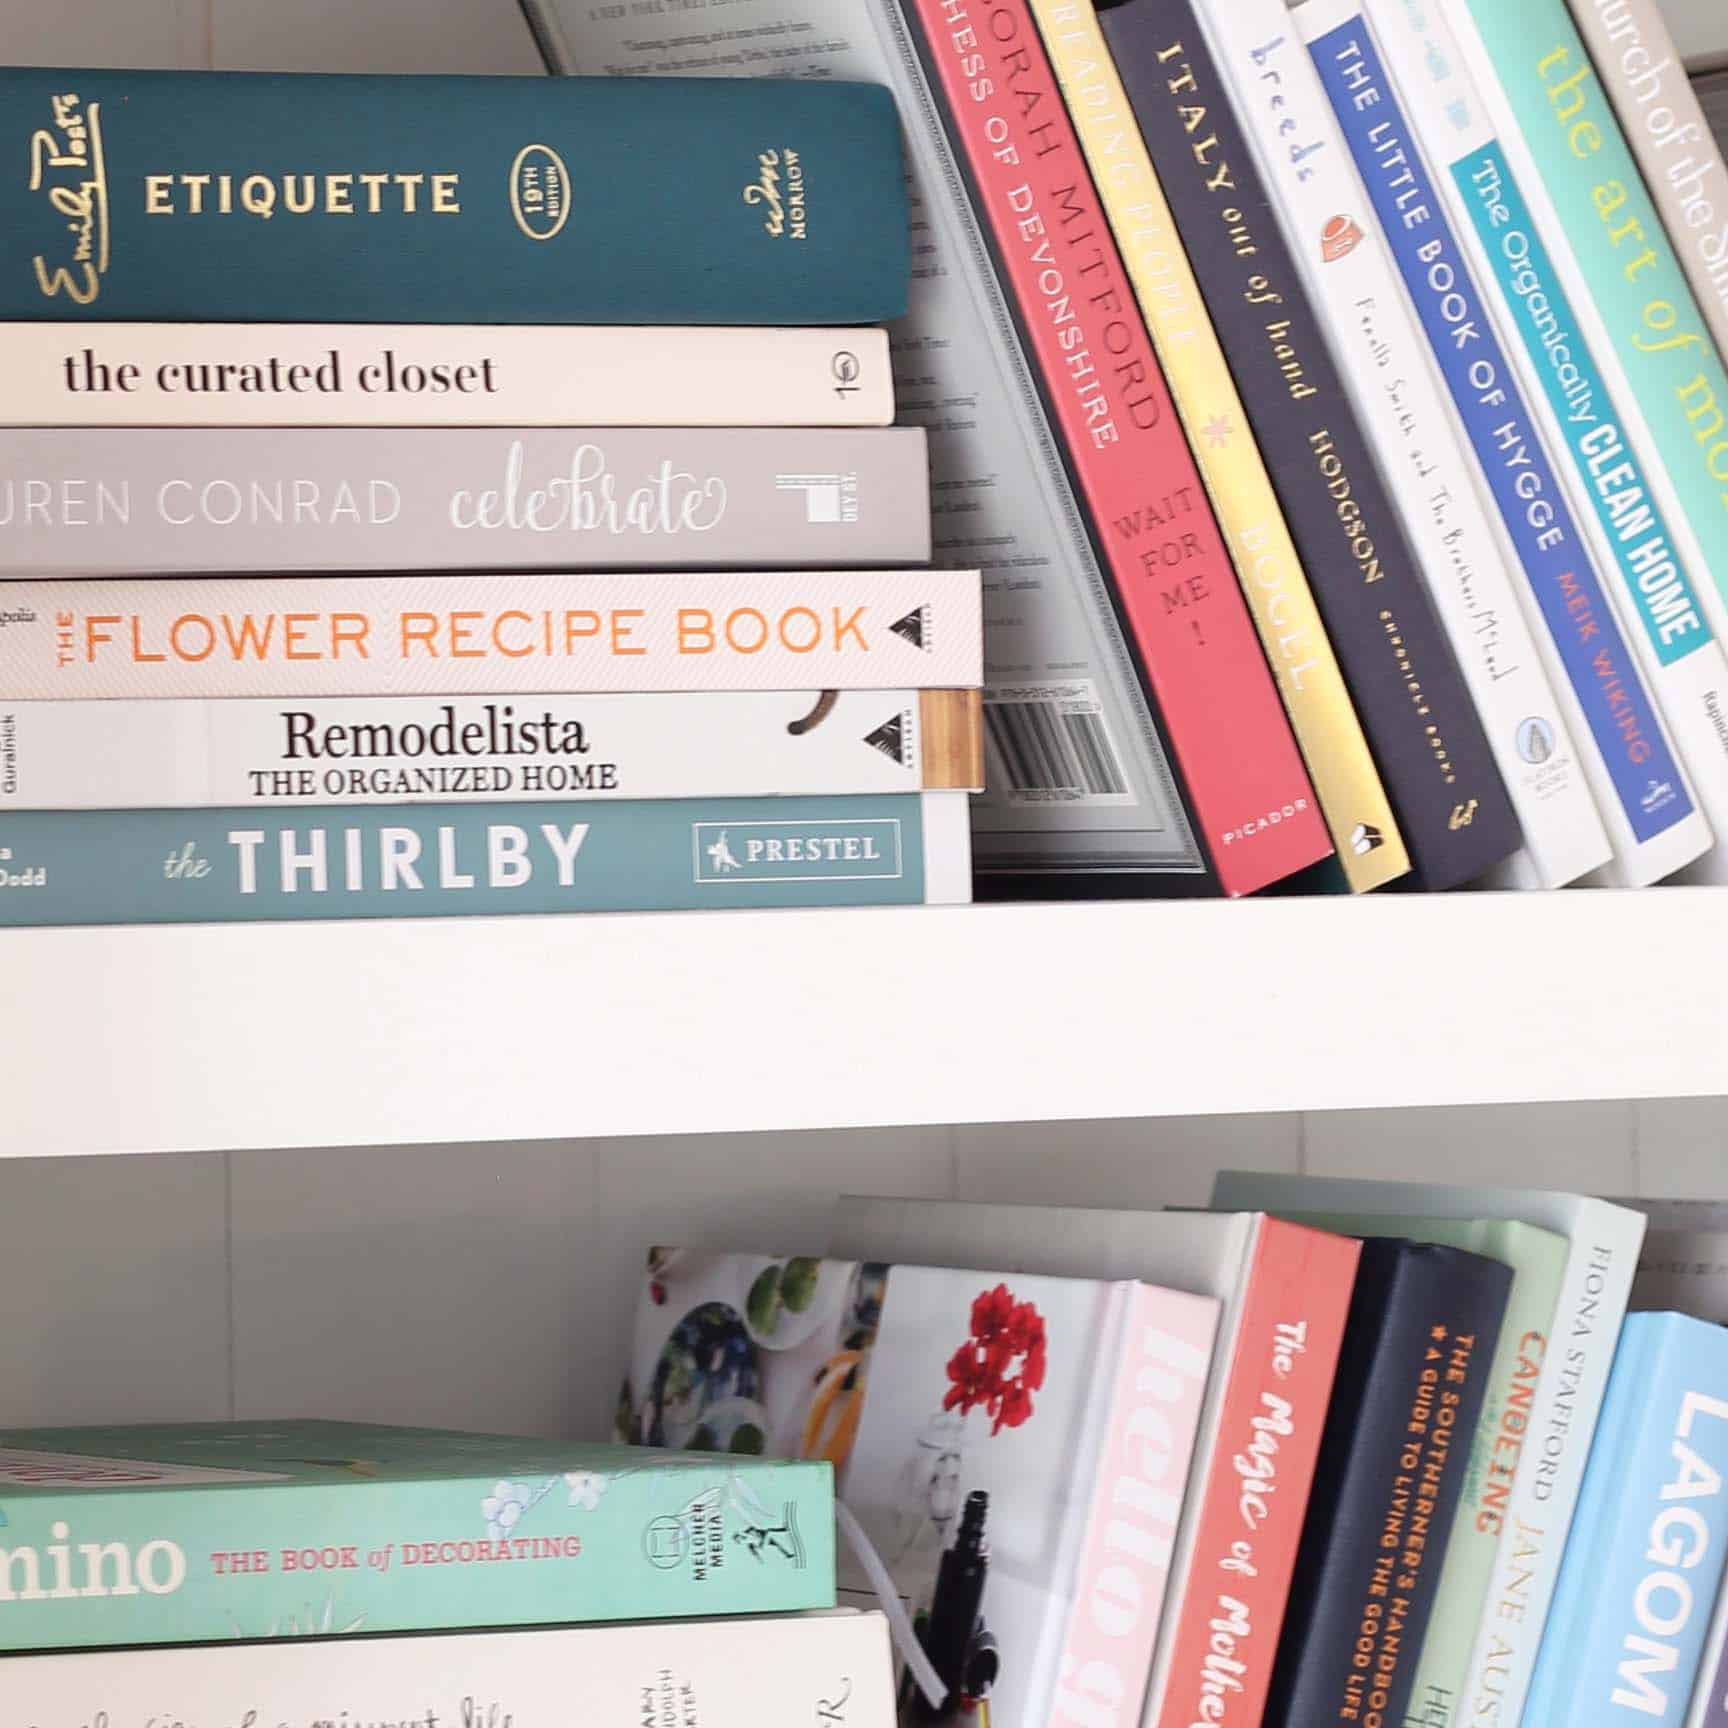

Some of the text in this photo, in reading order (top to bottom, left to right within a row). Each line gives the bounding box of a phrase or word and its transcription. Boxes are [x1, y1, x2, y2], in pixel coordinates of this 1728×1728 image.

[1050, 5, 1138, 188] READING
[144, 173, 461, 215] ETIQUETTE
[784, 148, 807, 239] MORROW
[1156, 41, 1318, 400] ITALY out of hand
[1537, 45, 1711, 359] the art of
[984, 117, 1021, 167] OF
[1007, 183, 1119, 449] DEVONSHIRE
[1051, 185, 1159, 430] MITFORD
[1336, 39, 1565, 553] THE LITTLE BOOK OF HYGGE
[62, 349, 497, 392] the curated closet
[1472, 159, 1700, 647] The Organically CLEAN HOME
[156, 478, 400, 527] CONRAD
[449, 440, 727, 537] celebrate
[1114, 487, 1193, 540] WAIT
[1309, 429, 1384, 585] HODGSON
[1140, 533, 1206, 576] FOR
[1159, 576, 1209, 614] ME
[57, 604, 872, 667] THE FLOWER RECIPE BOOK
[1557, 569, 1651, 766] MEIK WIKING
[249, 760, 618, 795] THE ORGANIZED HOME
[281, 706, 589, 759] Remodelista
[163, 824, 589, 891] the THIRLBY
[746, 836, 880, 864] PRESTEL
[1223, 797, 1309, 848] PICADOR
[1273, 1320, 1307, 1378] The
[1450, 1334, 1475, 1385] THE
[1534, 1244, 1612, 1503] FIONA STAFFORD
[1234, 1391, 1294, 1530] Magic
[1476, 1331, 1547, 1537] CANOEING
[1089, 1327, 1210, 1637] hello
[1399, 1390, 1460, 1591] SOUTHERNER'S
[209, 1536, 581, 1575] THE BOOK of DECORATING
[693, 1503, 706, 1580] MELCHER
[710, 1514, 723, 1567] MEDIA
[1219, 1541, 1258, 1577] of
[1340, 1347, 1442, 1721] A GUIDE TO LIVING THE GOOD LIFE
[1500, 1516, 1545, 1623] JANE
[1610, 1392, 1728, 1717] LAGOM
